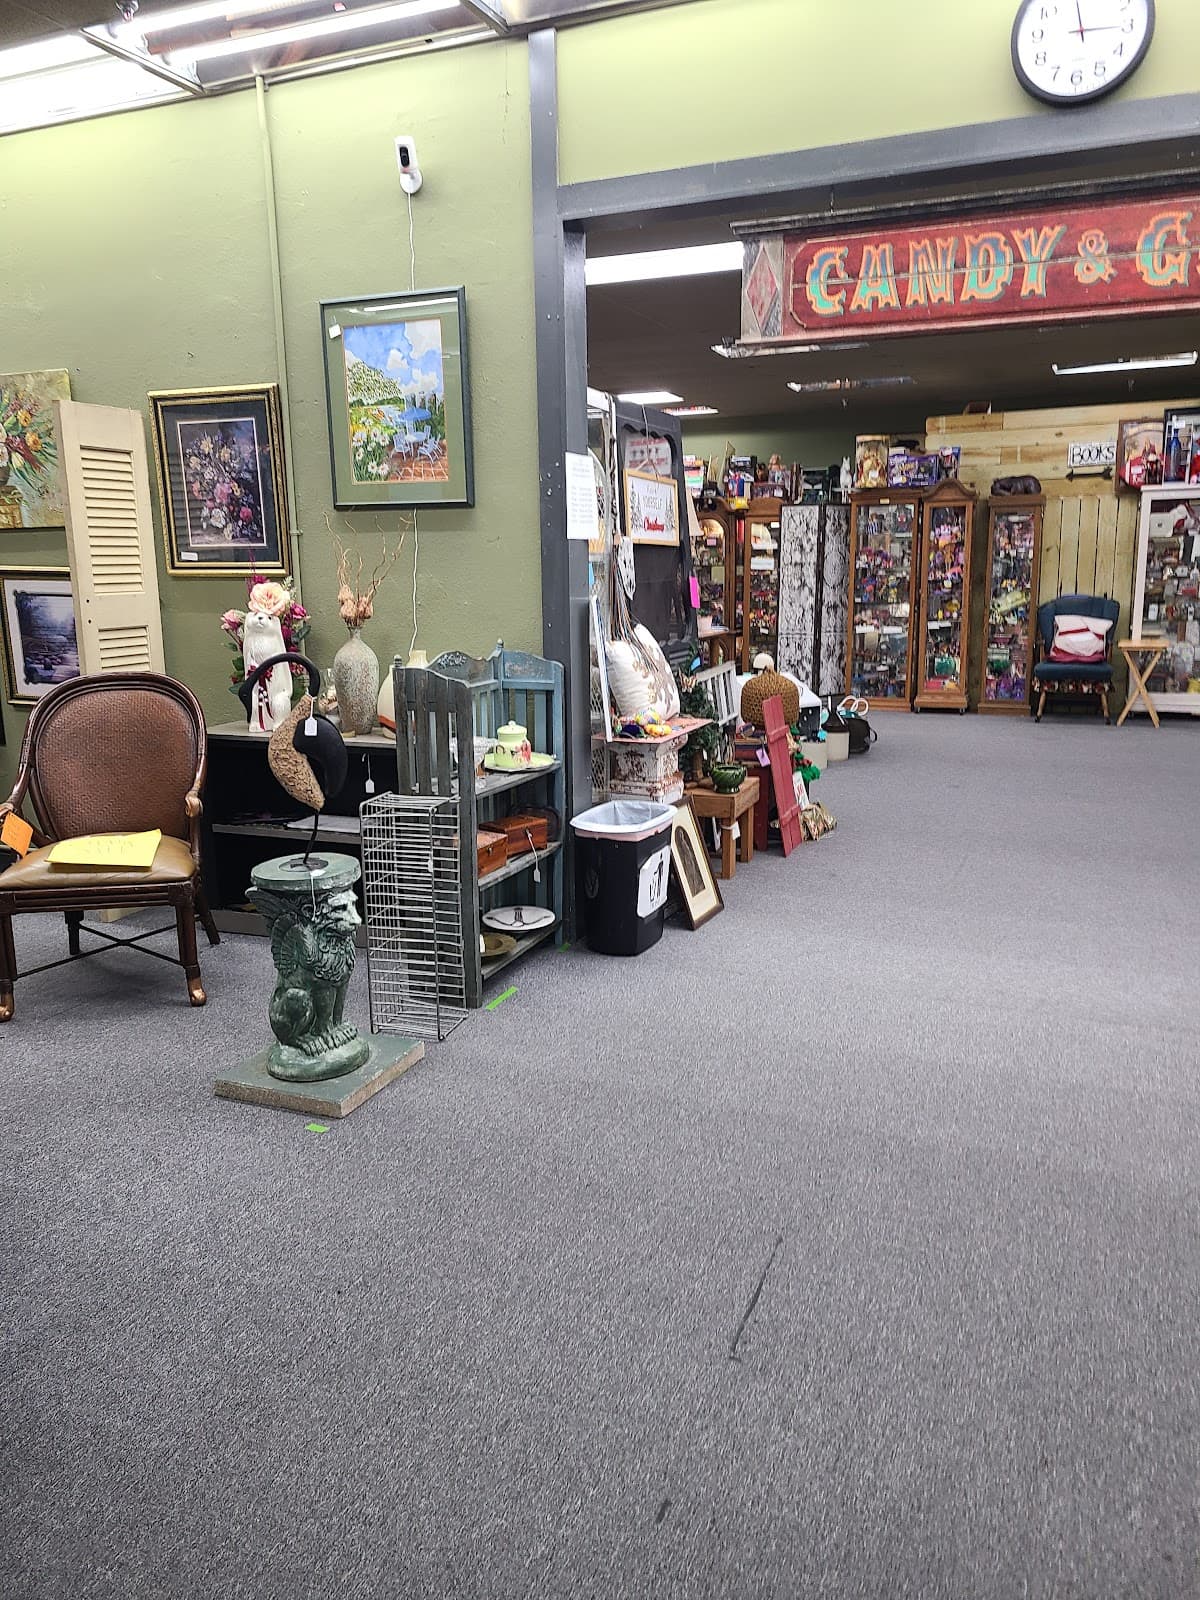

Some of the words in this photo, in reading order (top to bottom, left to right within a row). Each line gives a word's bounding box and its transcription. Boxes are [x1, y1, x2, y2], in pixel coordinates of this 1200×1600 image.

[1121, 18, 1134, 34] 3
[1031, 28, 1044, 44] 9
[1113, 42, 1124, 57] 4
[1035, 51, 1047, 66] 8
[1051, 65, 1061, 82] 7
[1094, 61, 1106, 77] 5
[1070, 70, 1083, 86] 6
[806, 224, 1067, 317] CANDY
[1074, 228, 1118, 286] &
[1136, 210, 1200, 288] G
[1072, 445, 1115, 464] BOOKS
